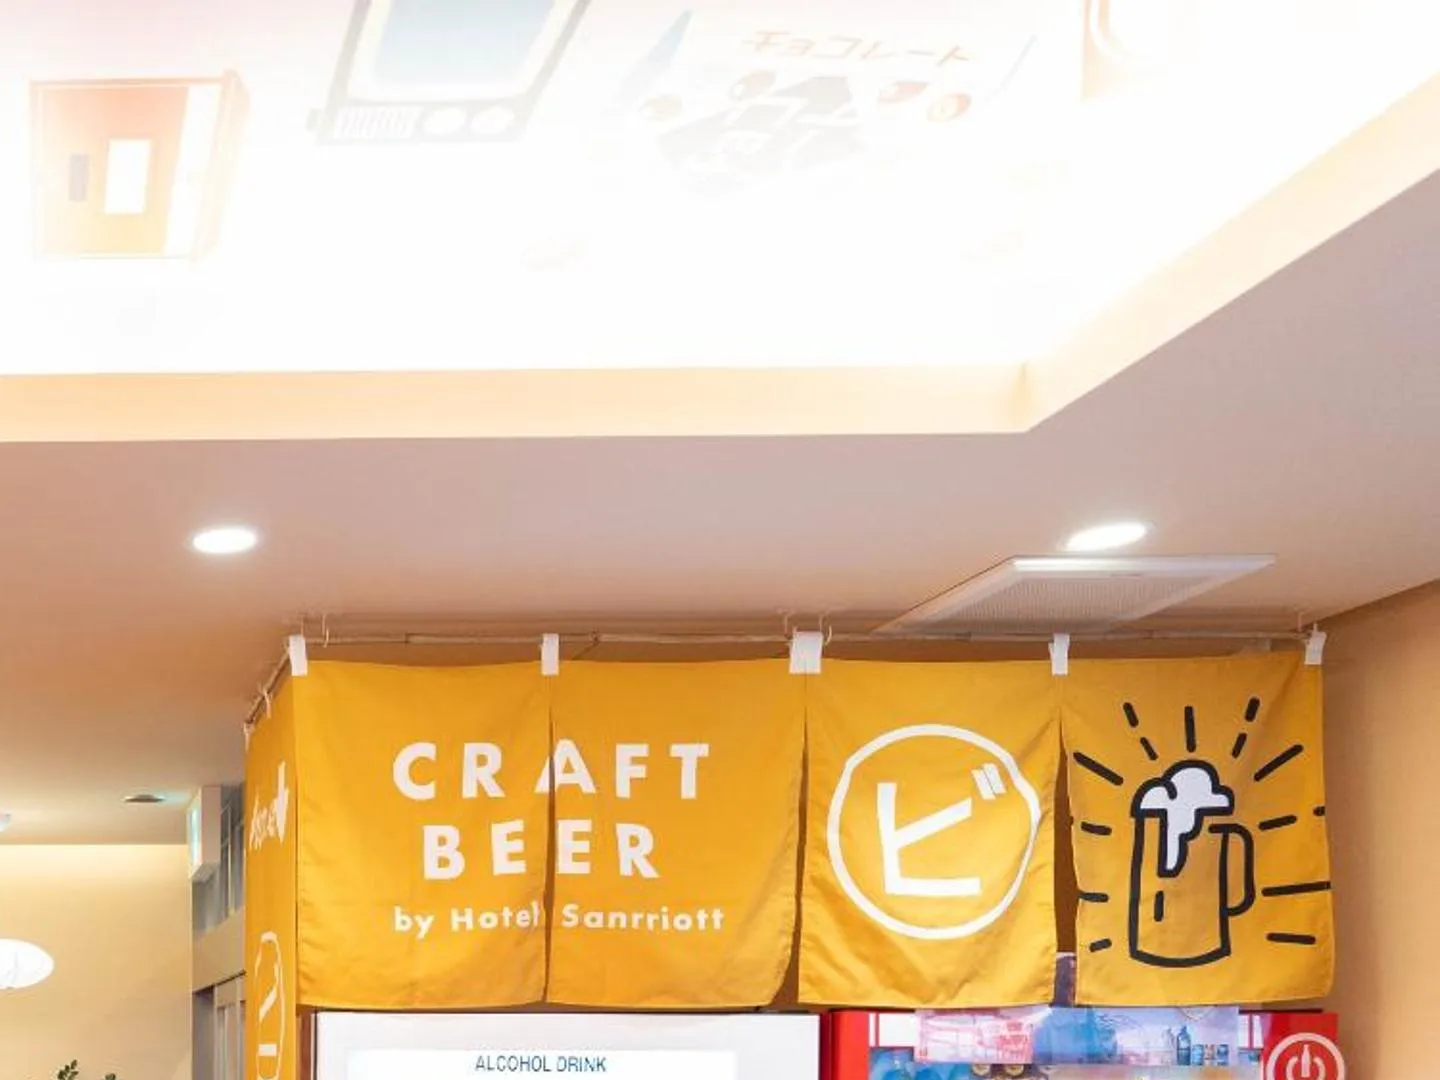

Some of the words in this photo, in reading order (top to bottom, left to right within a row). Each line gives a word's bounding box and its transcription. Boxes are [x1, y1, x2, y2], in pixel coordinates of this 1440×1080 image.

[743, 30, 971, 67] チョコレート
[392, 739, 710, 801] CRAFT
[422, 819, 660, 880] BEER
[876, 762, 1007, 898] ビ
[394, 906, 433, 939] by
[451, 901, 539, 931] Hotel
[562, 904, 725, 932] Sanrriott
[474, 1055, 552, 1073] ALCOHOL
[556, 1056, 607, 1073] DRINK
